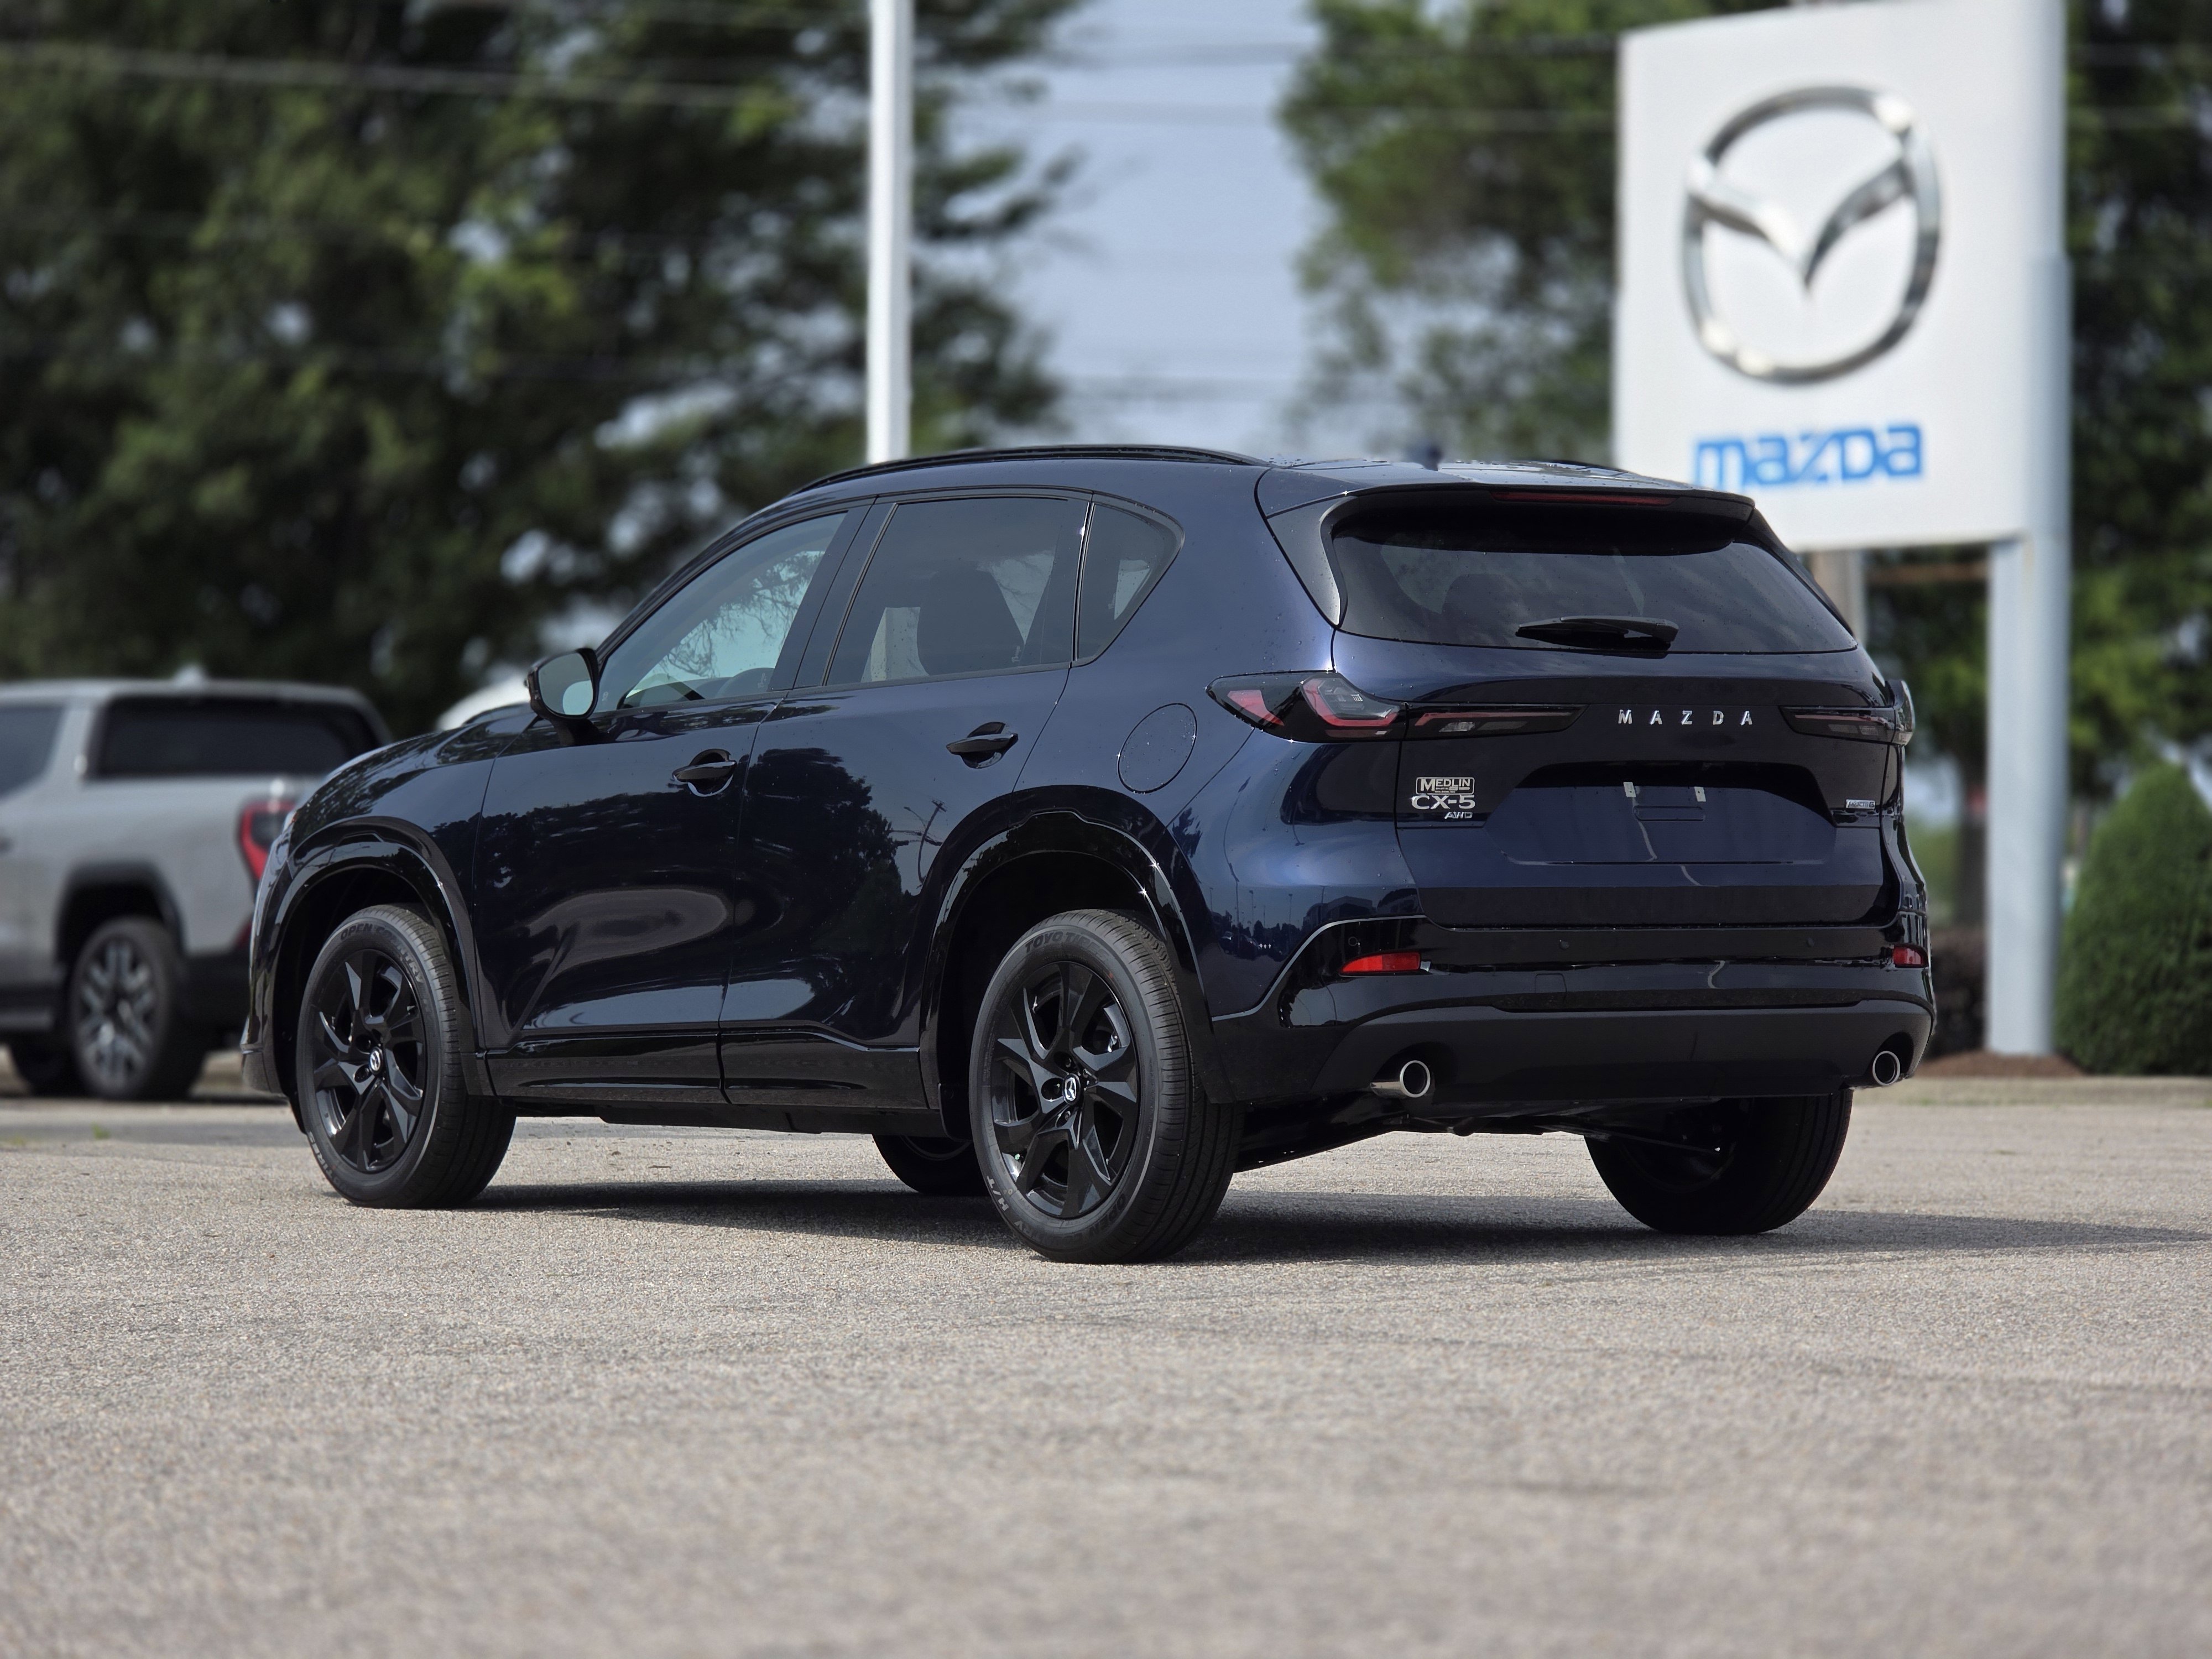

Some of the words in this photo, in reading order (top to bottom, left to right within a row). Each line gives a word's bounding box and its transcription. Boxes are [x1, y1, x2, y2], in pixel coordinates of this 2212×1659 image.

[1698, 426, 1921, 491] mazda
[1618, 709, 1752, 725] MAZDA
[1421, 778, 1470, 791] MEDLIN
[1411, 795, 1475, 810] CX-5
[340, 923, 373, 940] OPEN
[1025, 931, 1063, 953] TOYO
[1065, 931, 1110, 962] TIRES
[986, 1175, 1010, 1212] H/T
